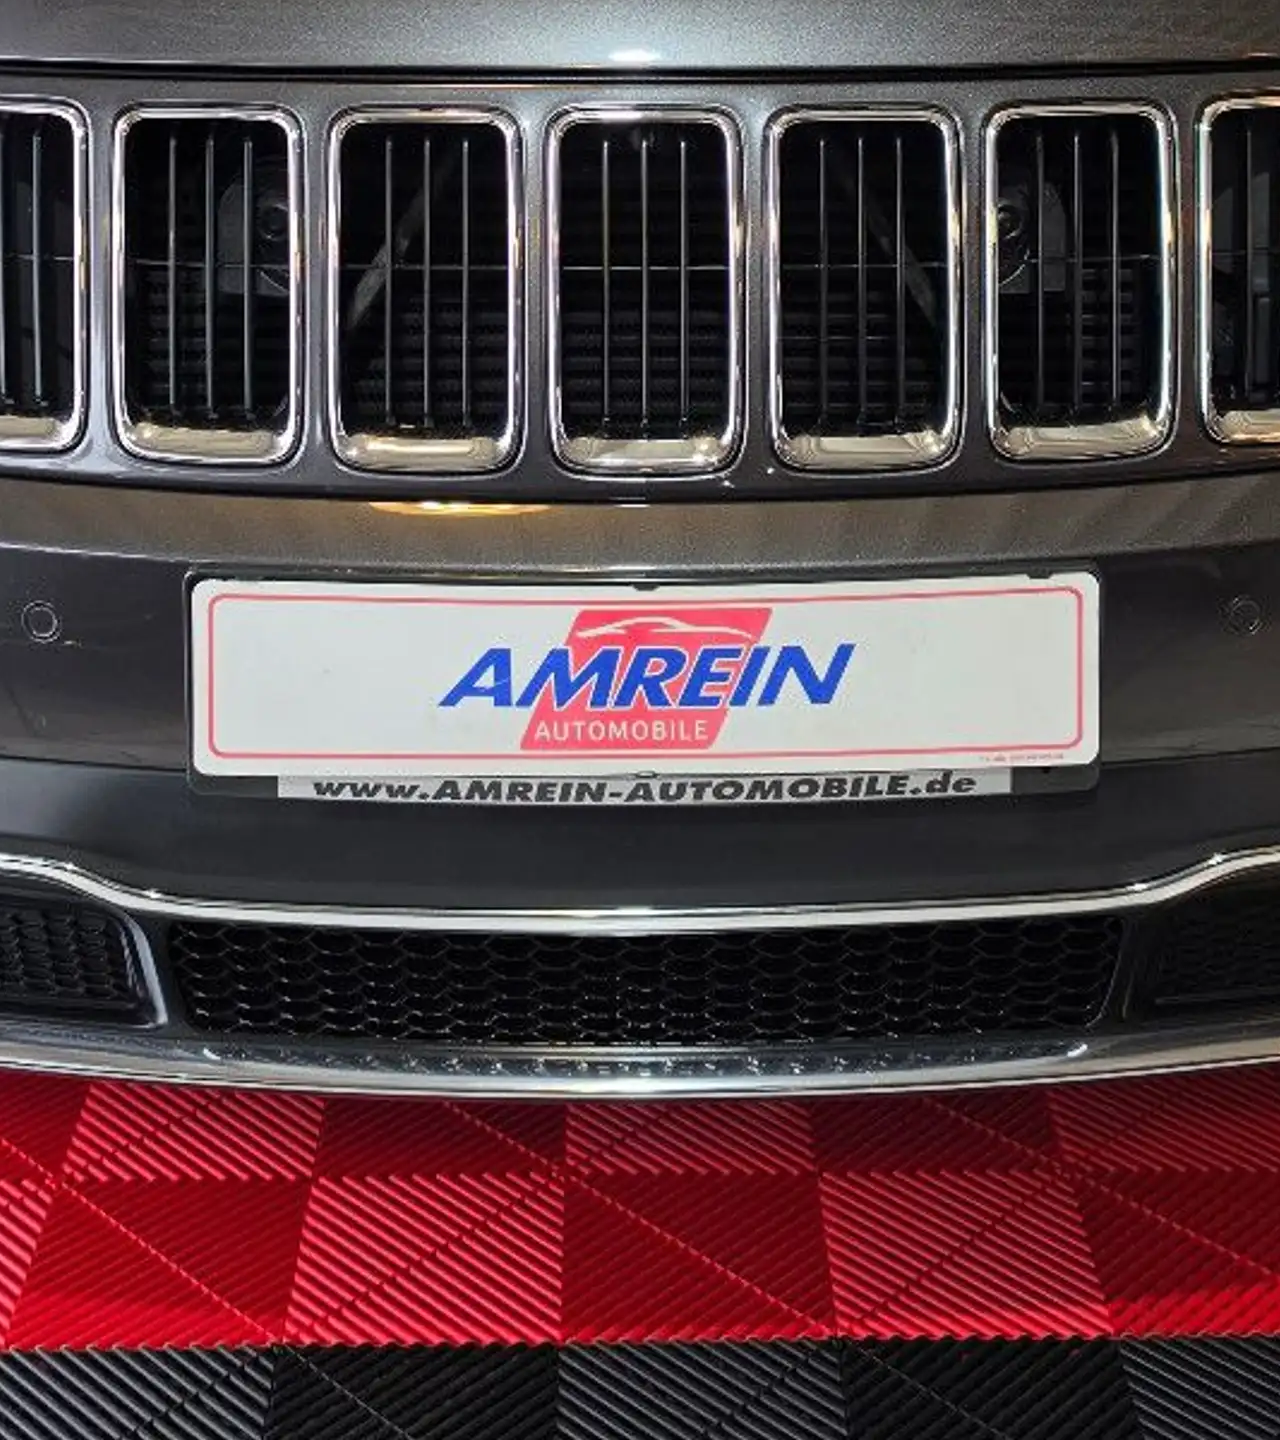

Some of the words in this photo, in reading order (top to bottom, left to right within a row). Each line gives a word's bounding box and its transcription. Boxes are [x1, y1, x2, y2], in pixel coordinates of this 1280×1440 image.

[437, 643, 857, 710] AMREIN
[534, 718, 709, 743] AUTOMOBILE
[314, 770, 977, 803] www.AMREIN-AUTOMOBILE.de
